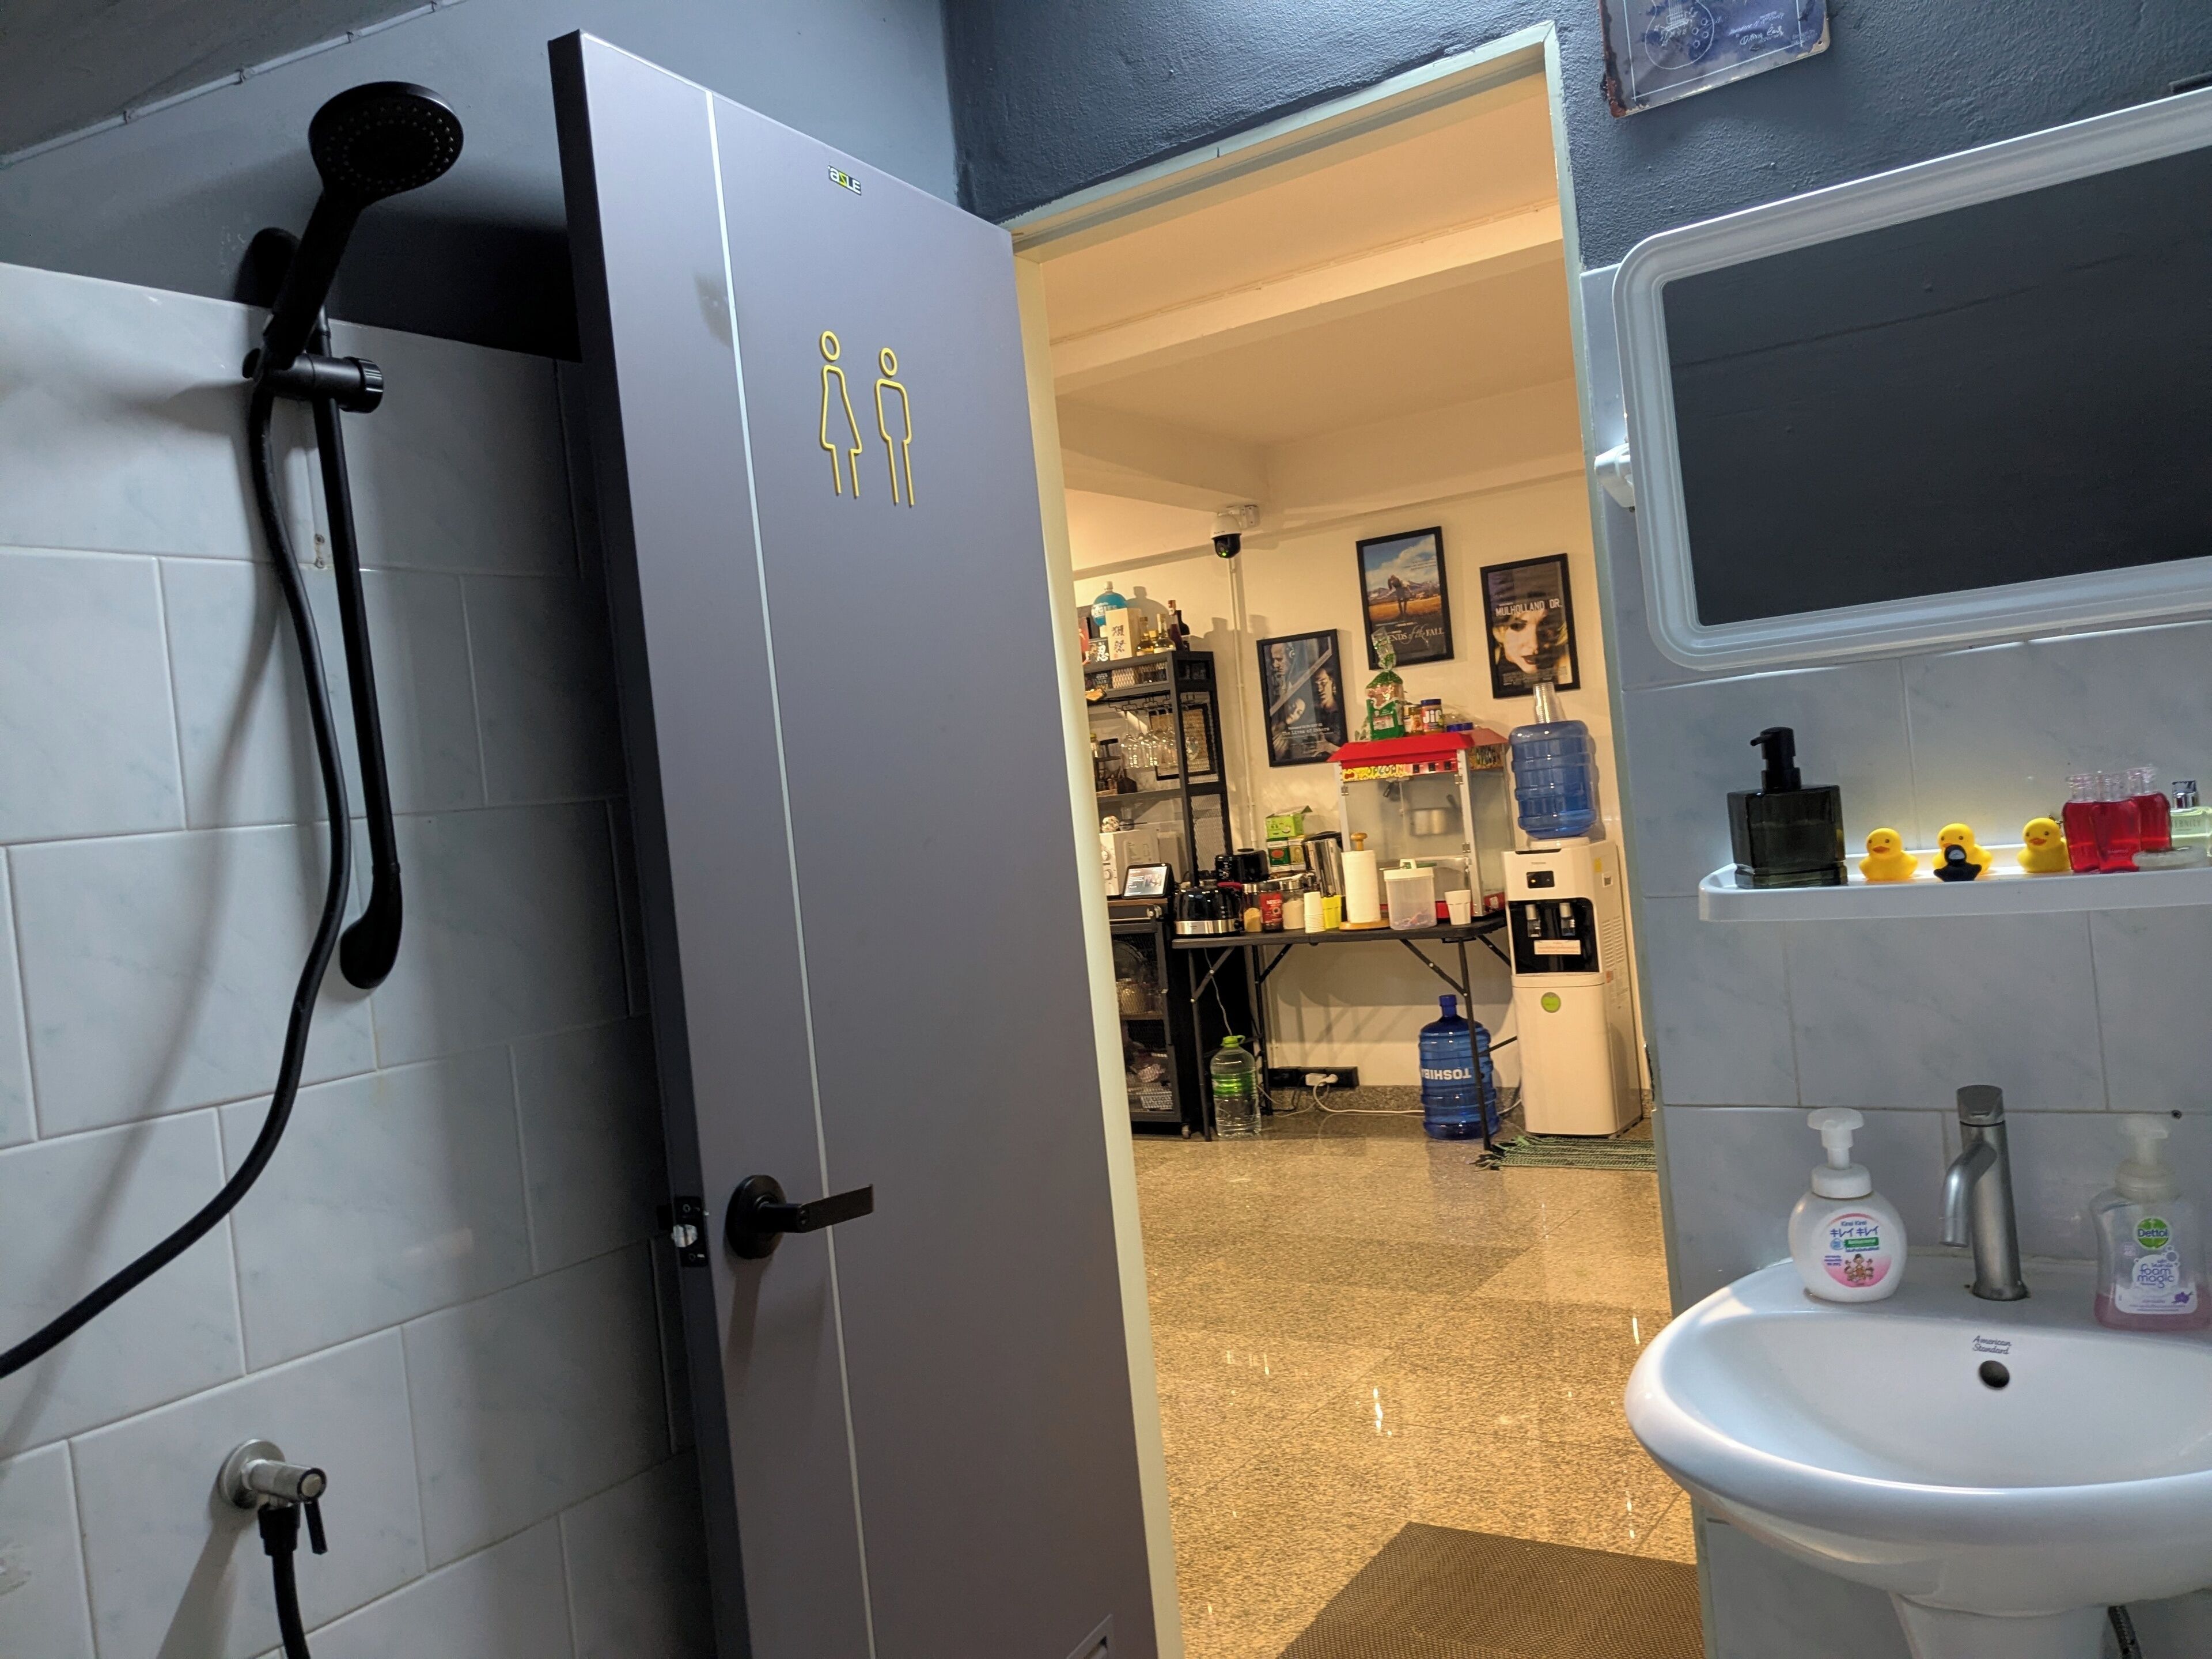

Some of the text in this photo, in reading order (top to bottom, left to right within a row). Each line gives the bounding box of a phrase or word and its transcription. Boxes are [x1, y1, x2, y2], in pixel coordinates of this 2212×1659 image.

[1495, 599, 1563, 616] MULHOLLAND DR.
[1426, 627, 1444, 637] FALL
[2172, 819, 2201, 828] ERNITY
[1830, 1225, 1879, 1237] キレイ キレイ
[2138, 1228, 2169, 1237] Dettol
[2139, 1263, 2171, 1275] foam
[2137, 1274, 2175, 1289] magic
[1972, 1335, 2012, 1346] American
[1972, 1343, 2009, 1355] Standard
